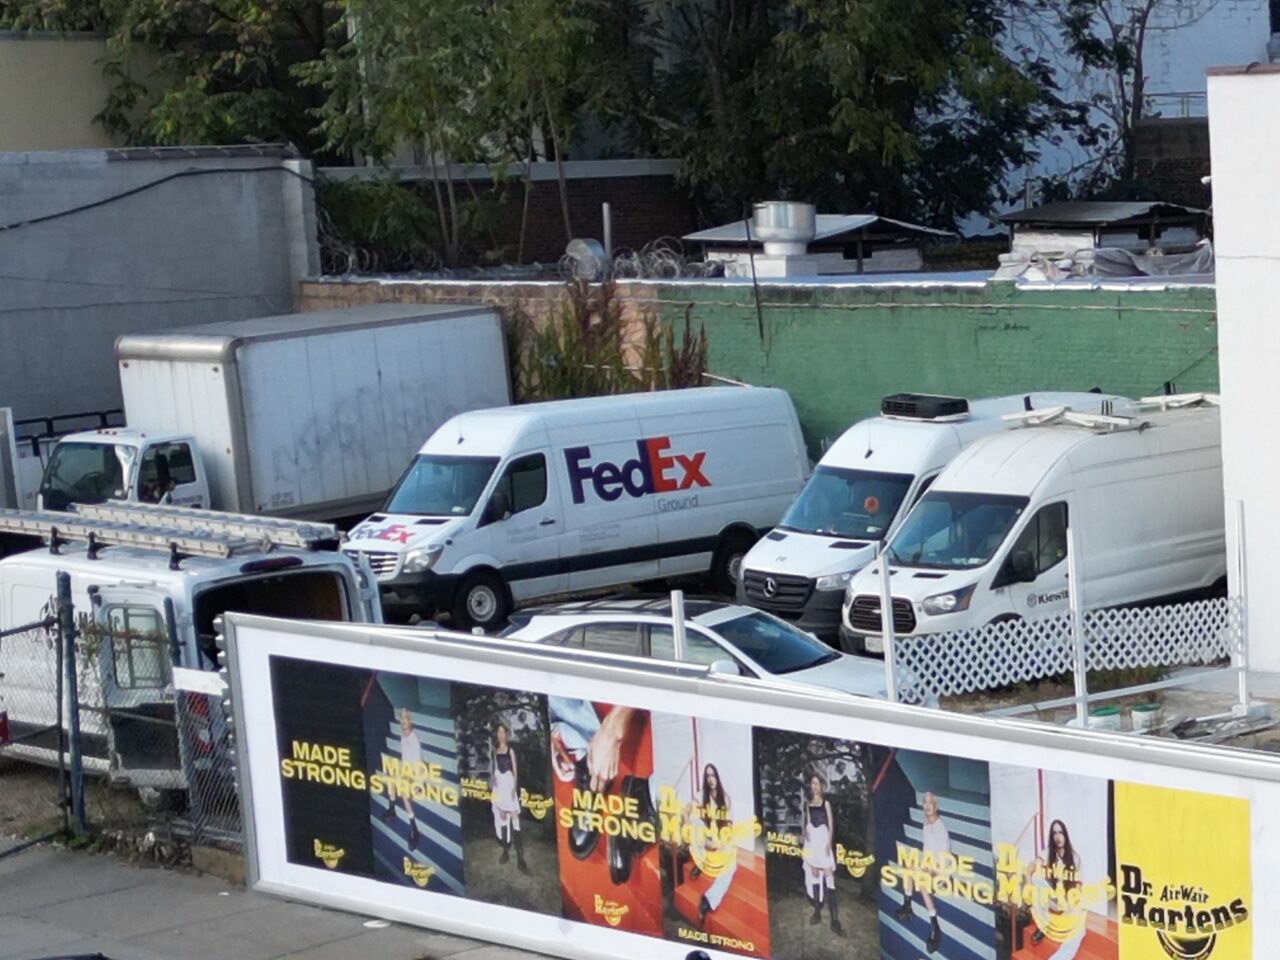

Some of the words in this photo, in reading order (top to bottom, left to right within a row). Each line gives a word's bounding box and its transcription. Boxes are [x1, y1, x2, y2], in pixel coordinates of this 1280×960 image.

[563, 436, 712, 505] FedEx
[657, 494, 698, 512] Ground
[349, 524, 417, 545] FedEx
[292, 740, 352, 768] MADE
[380, 752, 443, 783] MADE
[281, 759, 366, 790] STRONG
[369, 773, 459, 807] STRONG
[572, 788, 639, 818] MADE
[559, 807, 656, 844] STRONG
[767, 831, 799, 846] MADE
[895, 844, 976, 879] MADE
[880, 864, 994, 904] STRONG
[1120, 864, 1154, 898] Dr.
[1121, 894, 1249, 934] Martens
[677, 927, 708, 943] MADE
